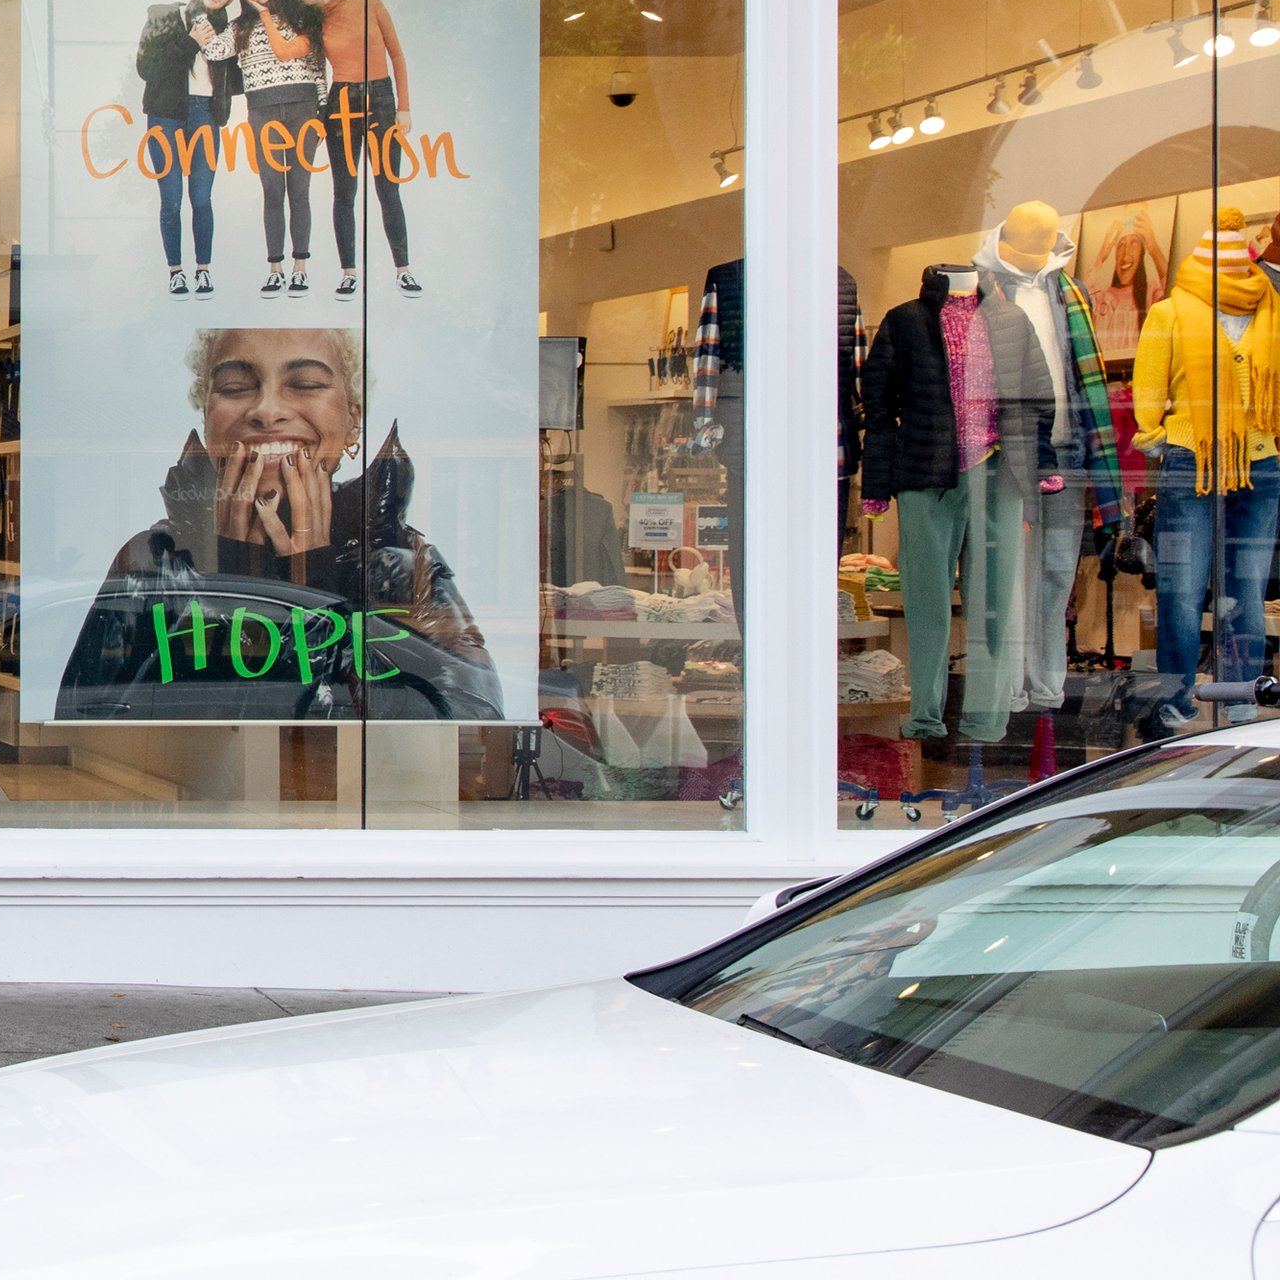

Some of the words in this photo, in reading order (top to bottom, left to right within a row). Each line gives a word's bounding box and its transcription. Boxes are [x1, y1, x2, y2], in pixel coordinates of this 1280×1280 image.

[81, 86, 470, 183] Connection
[658, 518, 675, 526] OFF
[152, 600, 410, 685] HOPE
